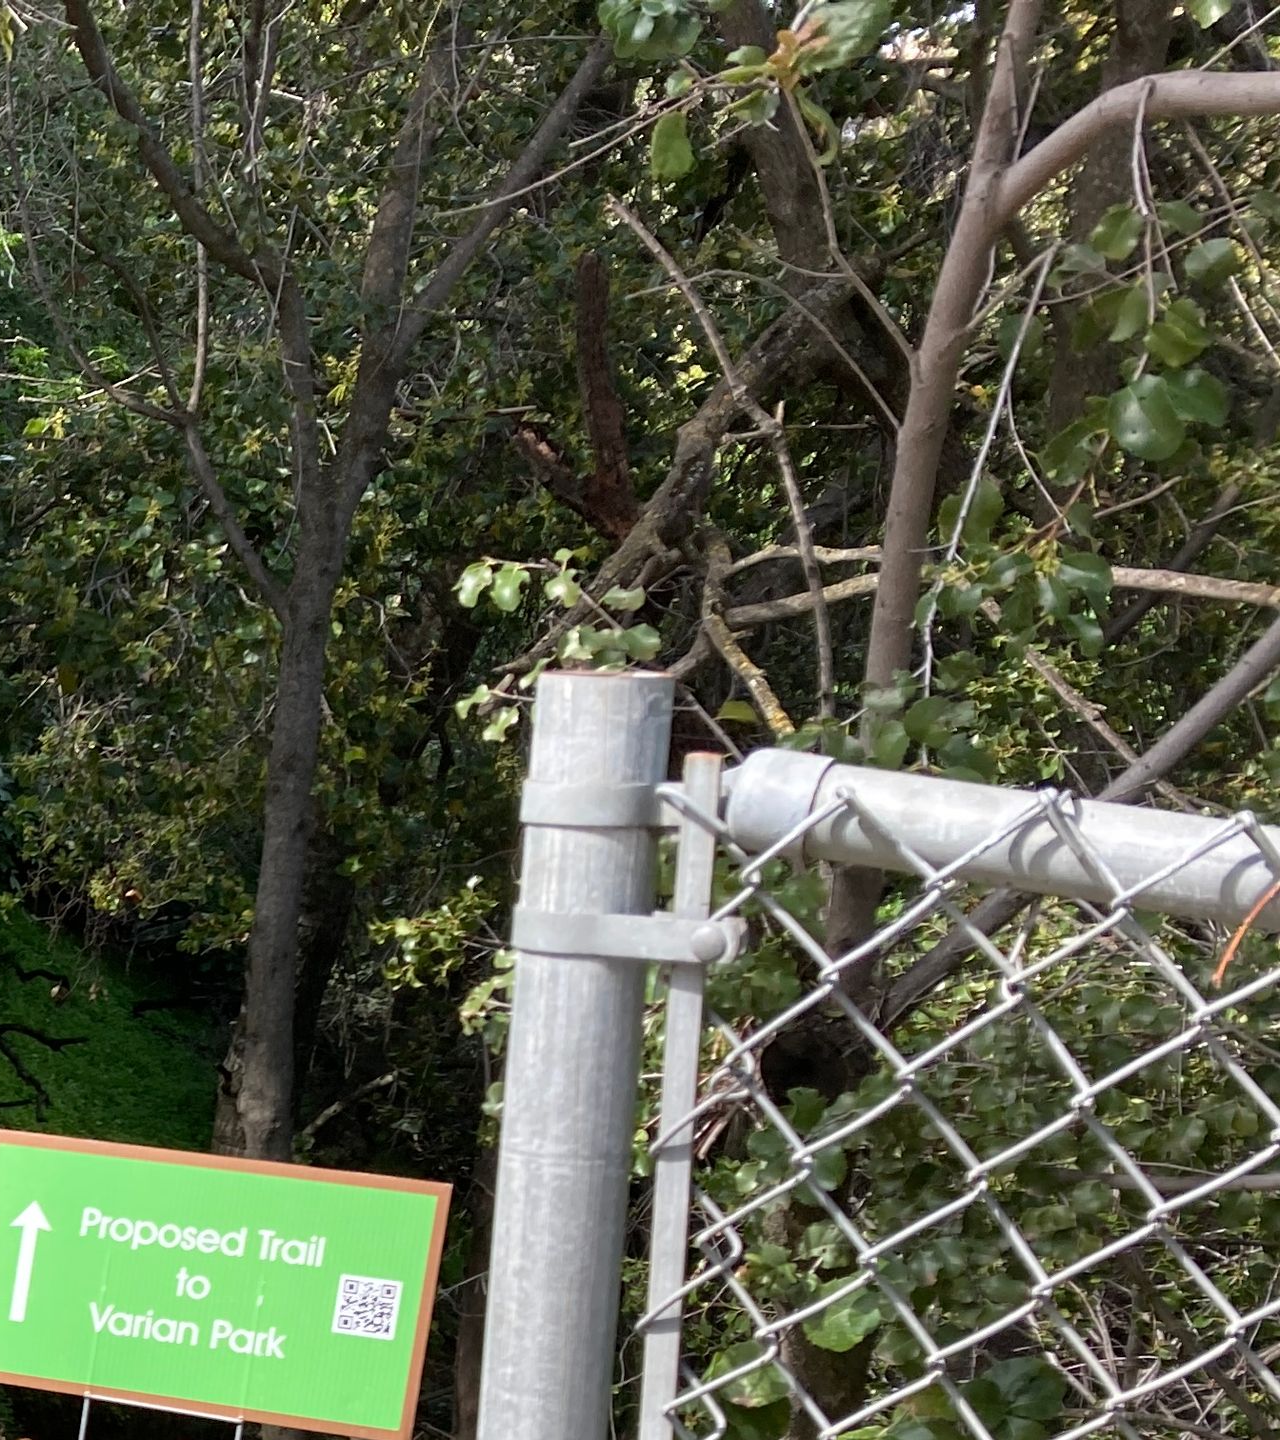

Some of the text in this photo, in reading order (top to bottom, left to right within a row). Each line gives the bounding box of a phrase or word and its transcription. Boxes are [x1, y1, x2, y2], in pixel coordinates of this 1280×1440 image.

[79, 1206, 327, 1268] Proposed Trail
[175, 1266, 212, 1301] to
[88, 1301, 287, 1360] Varian Park
